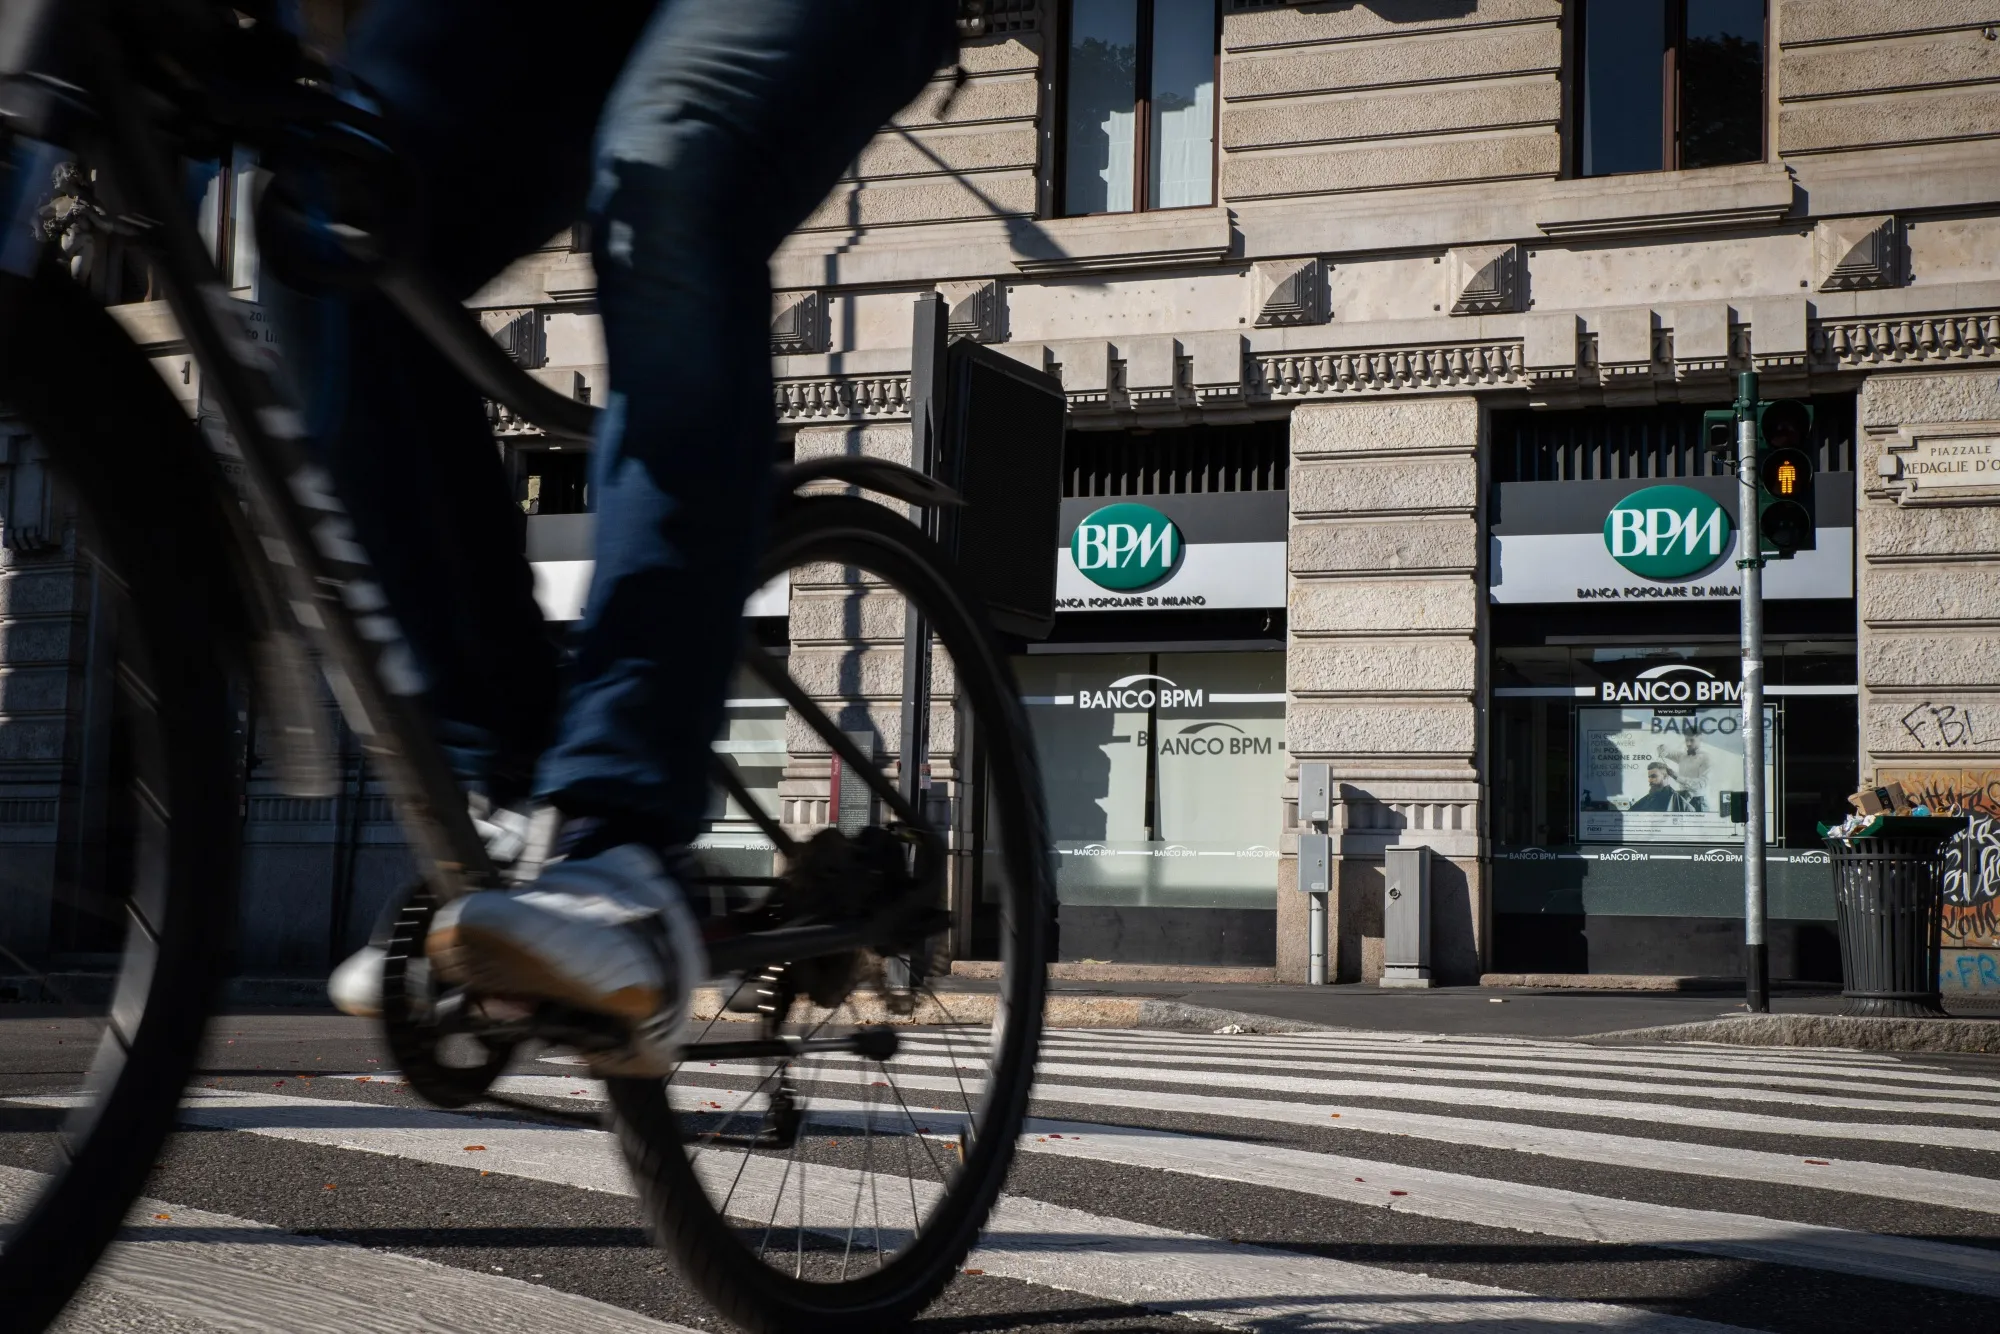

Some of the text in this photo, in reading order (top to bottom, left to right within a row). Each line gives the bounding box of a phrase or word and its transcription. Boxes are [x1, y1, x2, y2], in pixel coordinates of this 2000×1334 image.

[1930, 445, 1992, 457] PIAZZALE
[1903, 460, 1969, 475] MEDAGLIE
[1612, 507, 1721, 557] BPM
[1078, 522, 1172, 570] BPM
[1576, 585, 1742, 599] BANCA POPOLARE DI MILA
[1055, 595, 1206, 609] ANCA POPOLARE DI MILANO
[1602, 681, 1745, 701] BANCO BPM
[1079, 688, 1203, 709] BANCO BPM
[1229, 737, 1272, 755] BPM
[744, 843, 770, 852] BANCO
[1073, 848, 1116, 857] BANCO BPM
[1154, 849, 1197, 858] BANCO BPM
[1236, 850, 1280, 858] BANCO BPM
[1509, 852, 1539, 860] BANCO
[1600, 853, 1648, 861] BANCO BPM
[1693, 854, 1743, 862] BANCO BPM
[1789, 855, 1821, 864] BANCO
